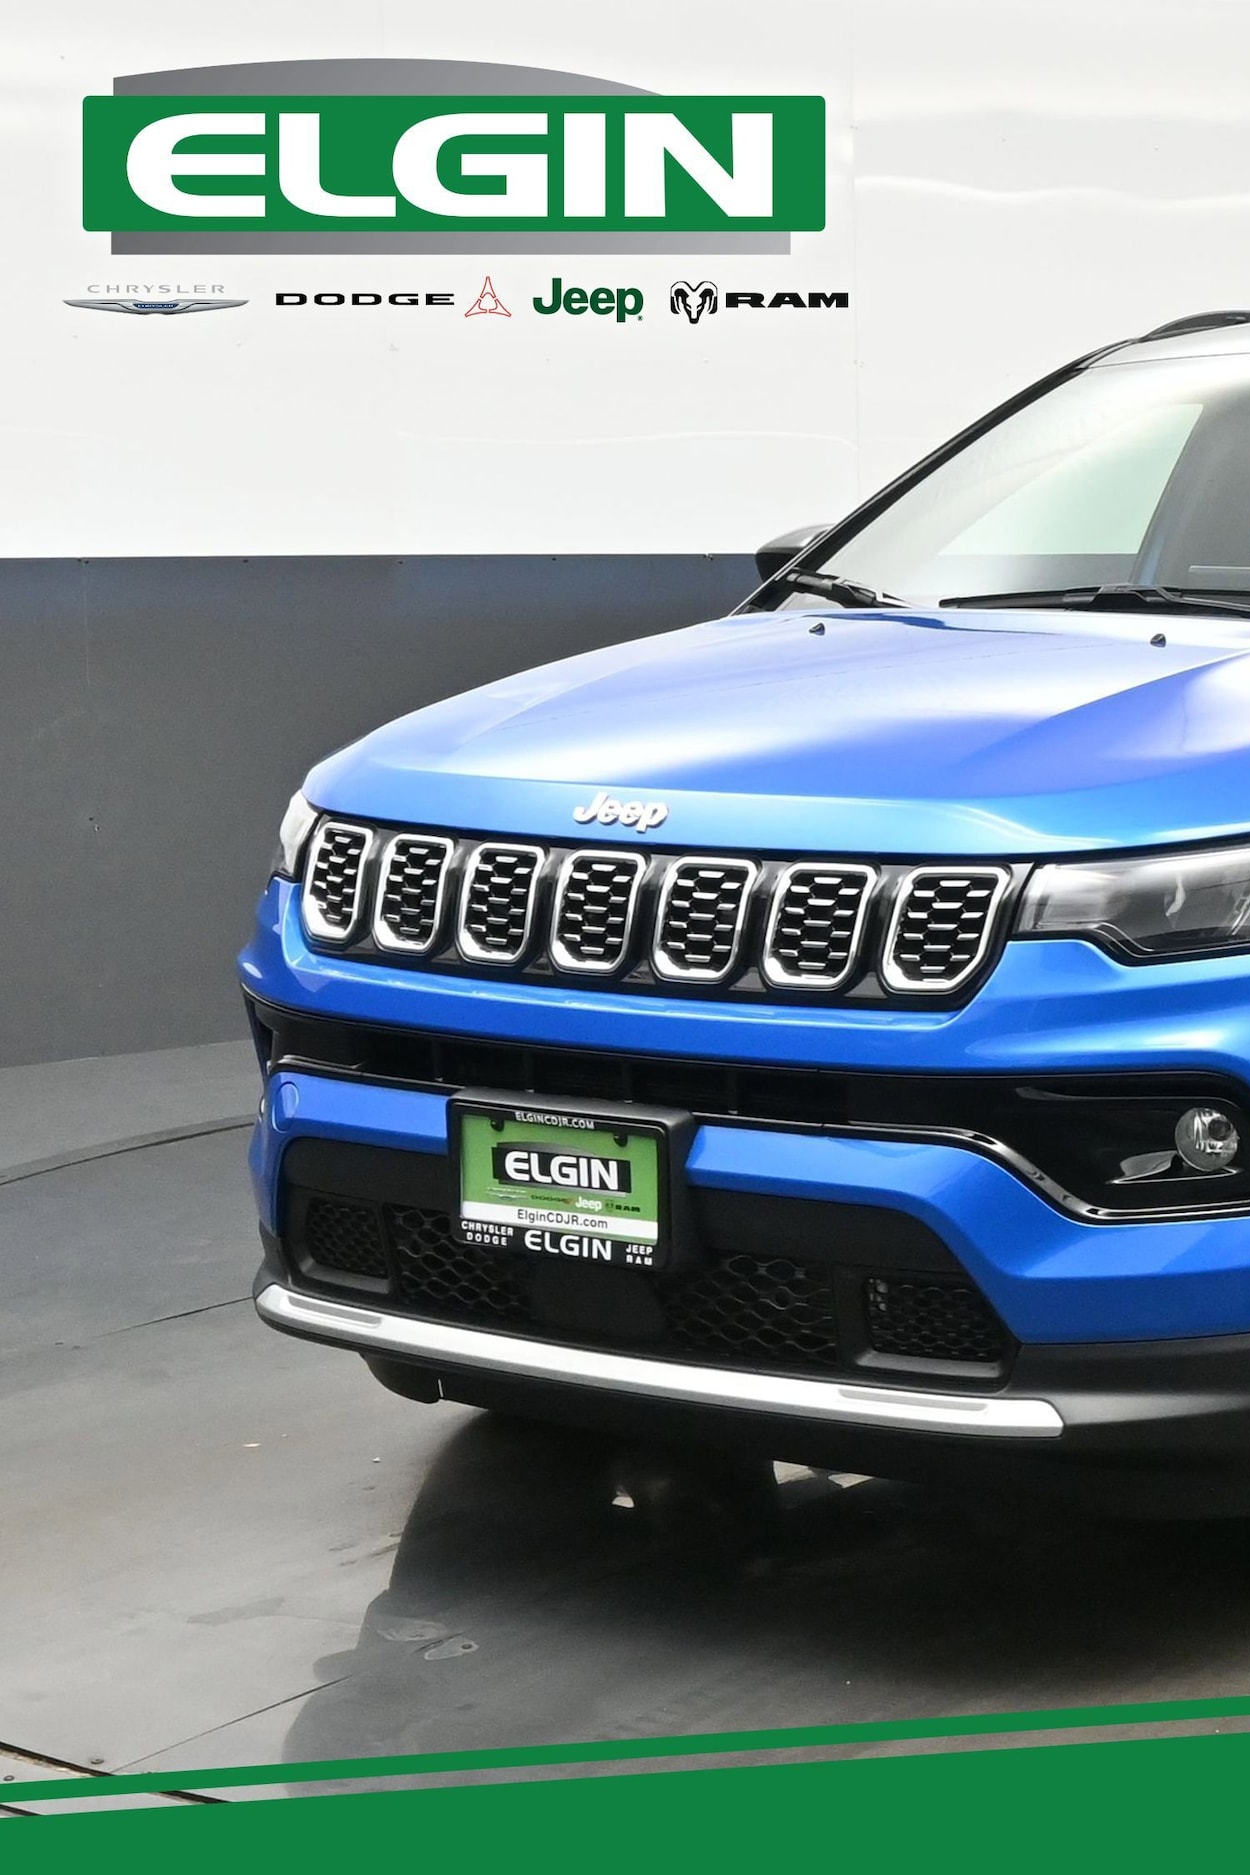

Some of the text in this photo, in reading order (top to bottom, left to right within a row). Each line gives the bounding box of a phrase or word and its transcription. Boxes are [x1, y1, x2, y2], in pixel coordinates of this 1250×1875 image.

[573, 792, 669, 833] Jeep
[514, 1111, 596, 1130] ELGINCDJR.COM
[504, 1150, 619, 1191] ELGIN
[575, 1196, 602, 1212] Jeep
[516, 1208, 609, 1230] ElginCDJR.com
[461, 1220, 514, 1237] CHRYSLER
[466, 1231, 508, 1246] DODGE
[524, 1230, 612, 1261] ELGIN
[625, 1244, 653, 1255] JEEP
[626, 1254, 653, 1266] RAM
